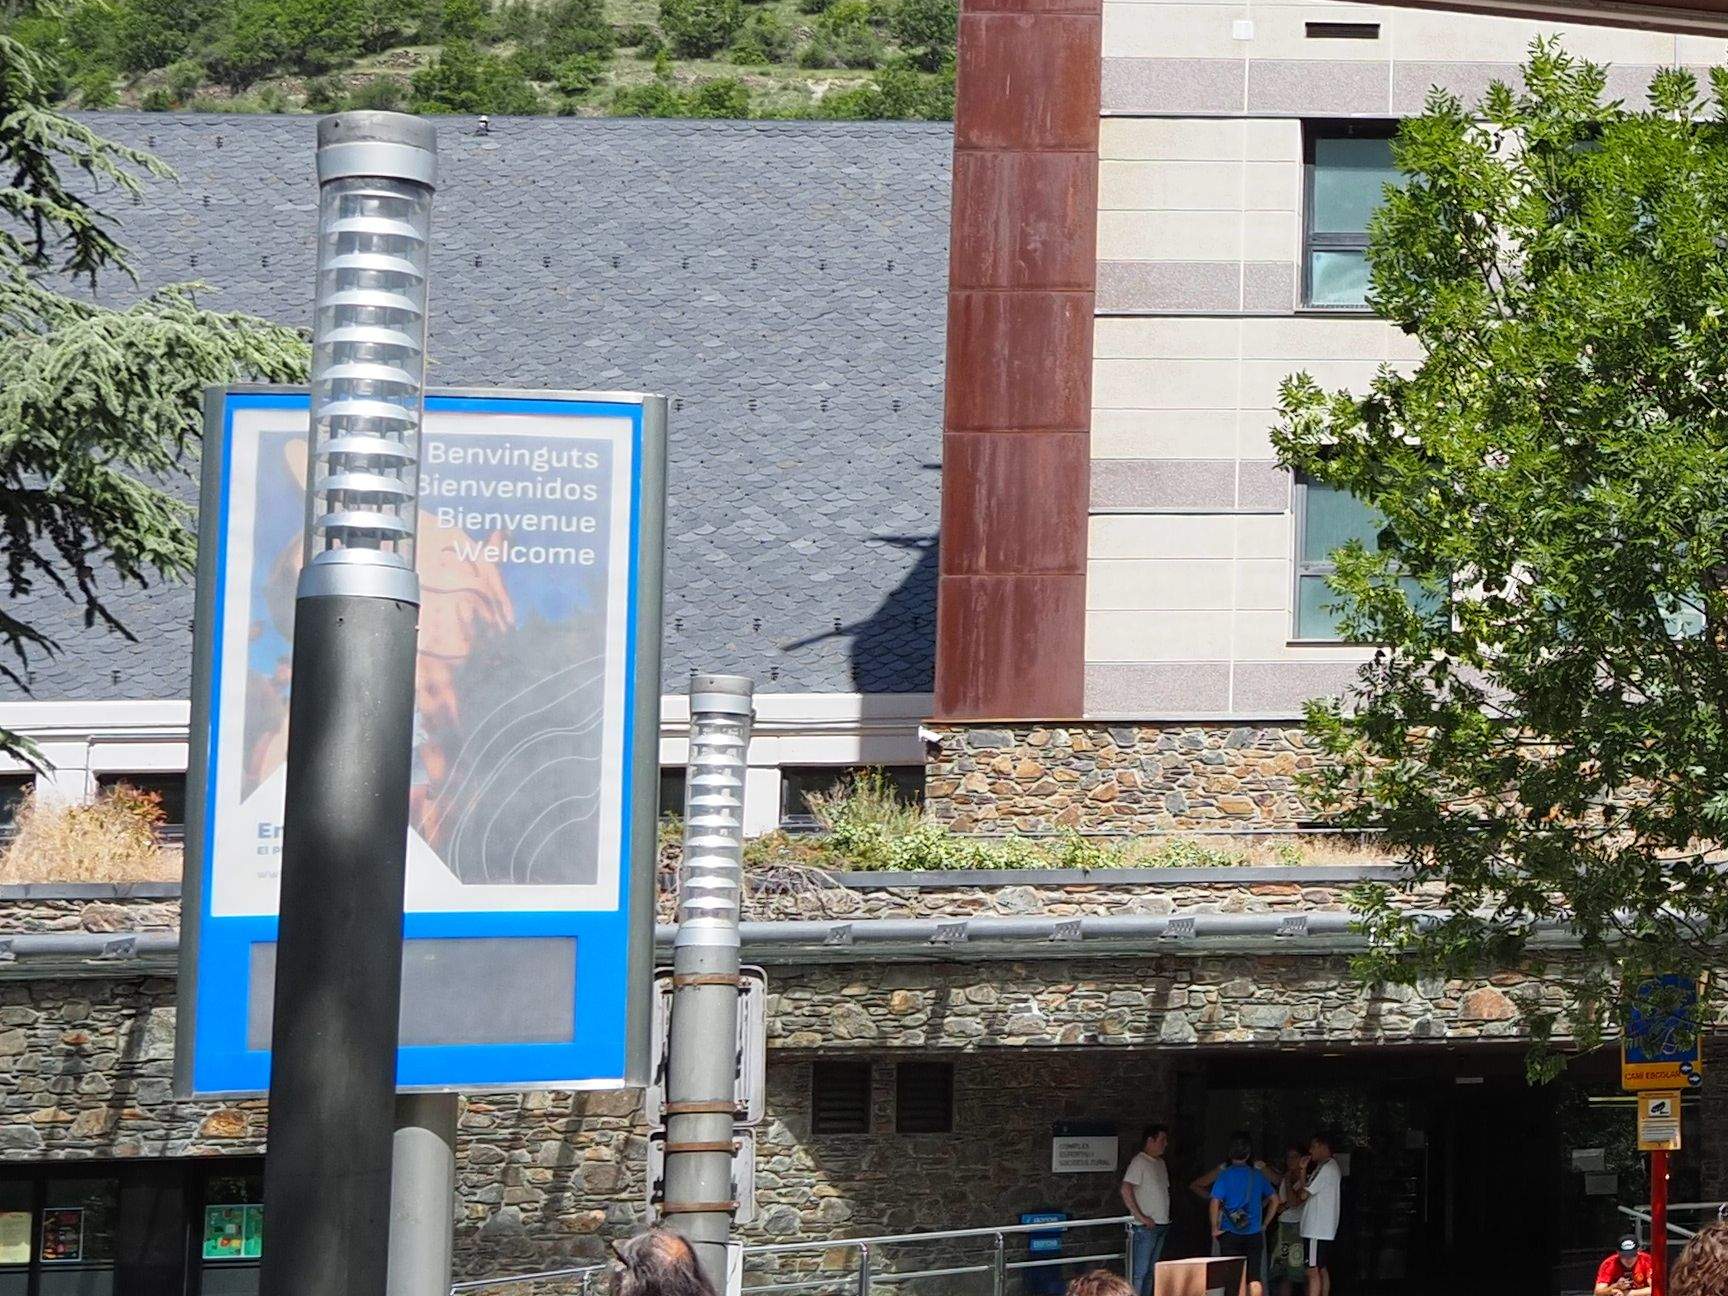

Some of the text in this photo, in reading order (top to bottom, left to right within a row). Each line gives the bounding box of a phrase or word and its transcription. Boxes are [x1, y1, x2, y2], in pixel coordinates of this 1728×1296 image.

[427, 441, 600, 472] Benvinguts
[418, 473, 598, 501] Bienvenidos
[436, 506, 597, 533] Bienvenue
[453, 540, 596, 565] Welcome
